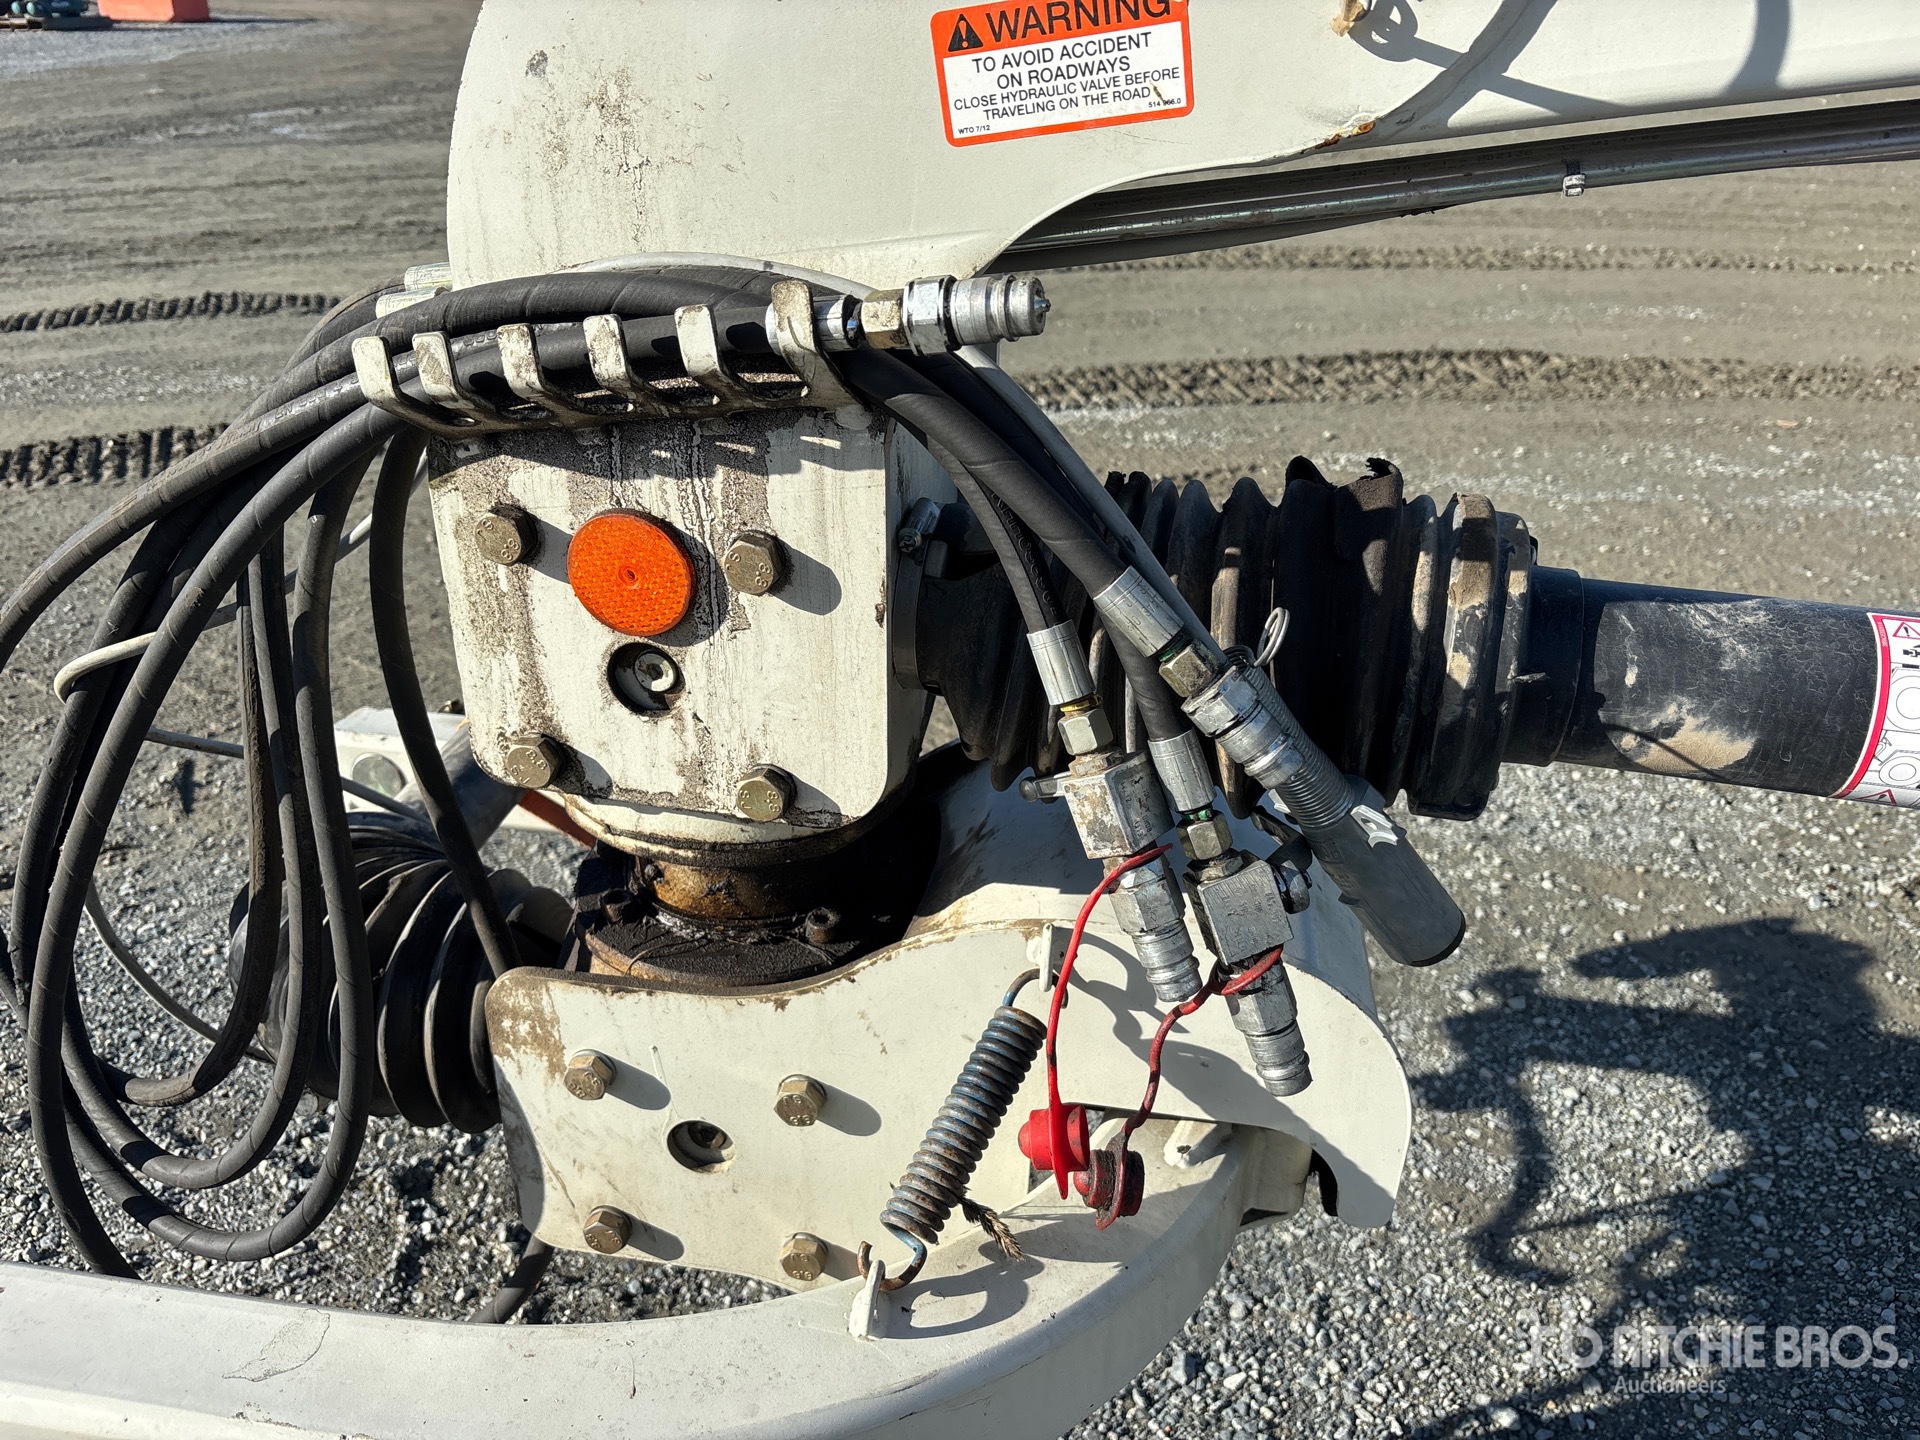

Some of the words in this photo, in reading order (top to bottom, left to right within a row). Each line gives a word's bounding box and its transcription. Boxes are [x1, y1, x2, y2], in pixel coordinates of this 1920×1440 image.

[986, 0, 1171, 43] WARNING
[972, 56, 996, 74] TO
[1001, 48, 1054, 69] AVOID
[1060, 32, 1152, 60] ACCIDENT
[954, 94, 997, 111] CLOSE
[1001, 82, 1077, 103] HYDRAULIC
[1080, 76, 1121, 92] VALVE
[1125, 67, 1180, 86] BEFORE
[997, 73, 1022, 90] ON
[1028, 56, 1131, 84] ROADWAYS
[984, 100, 1056, 121] TRAVELING
[1059, 96, 1079, 110] ON
[1082, 92, 1109, 107] THE
[1112, 86, 1151, 103] ROAD
[976, 124, 990, 133] 7/12
